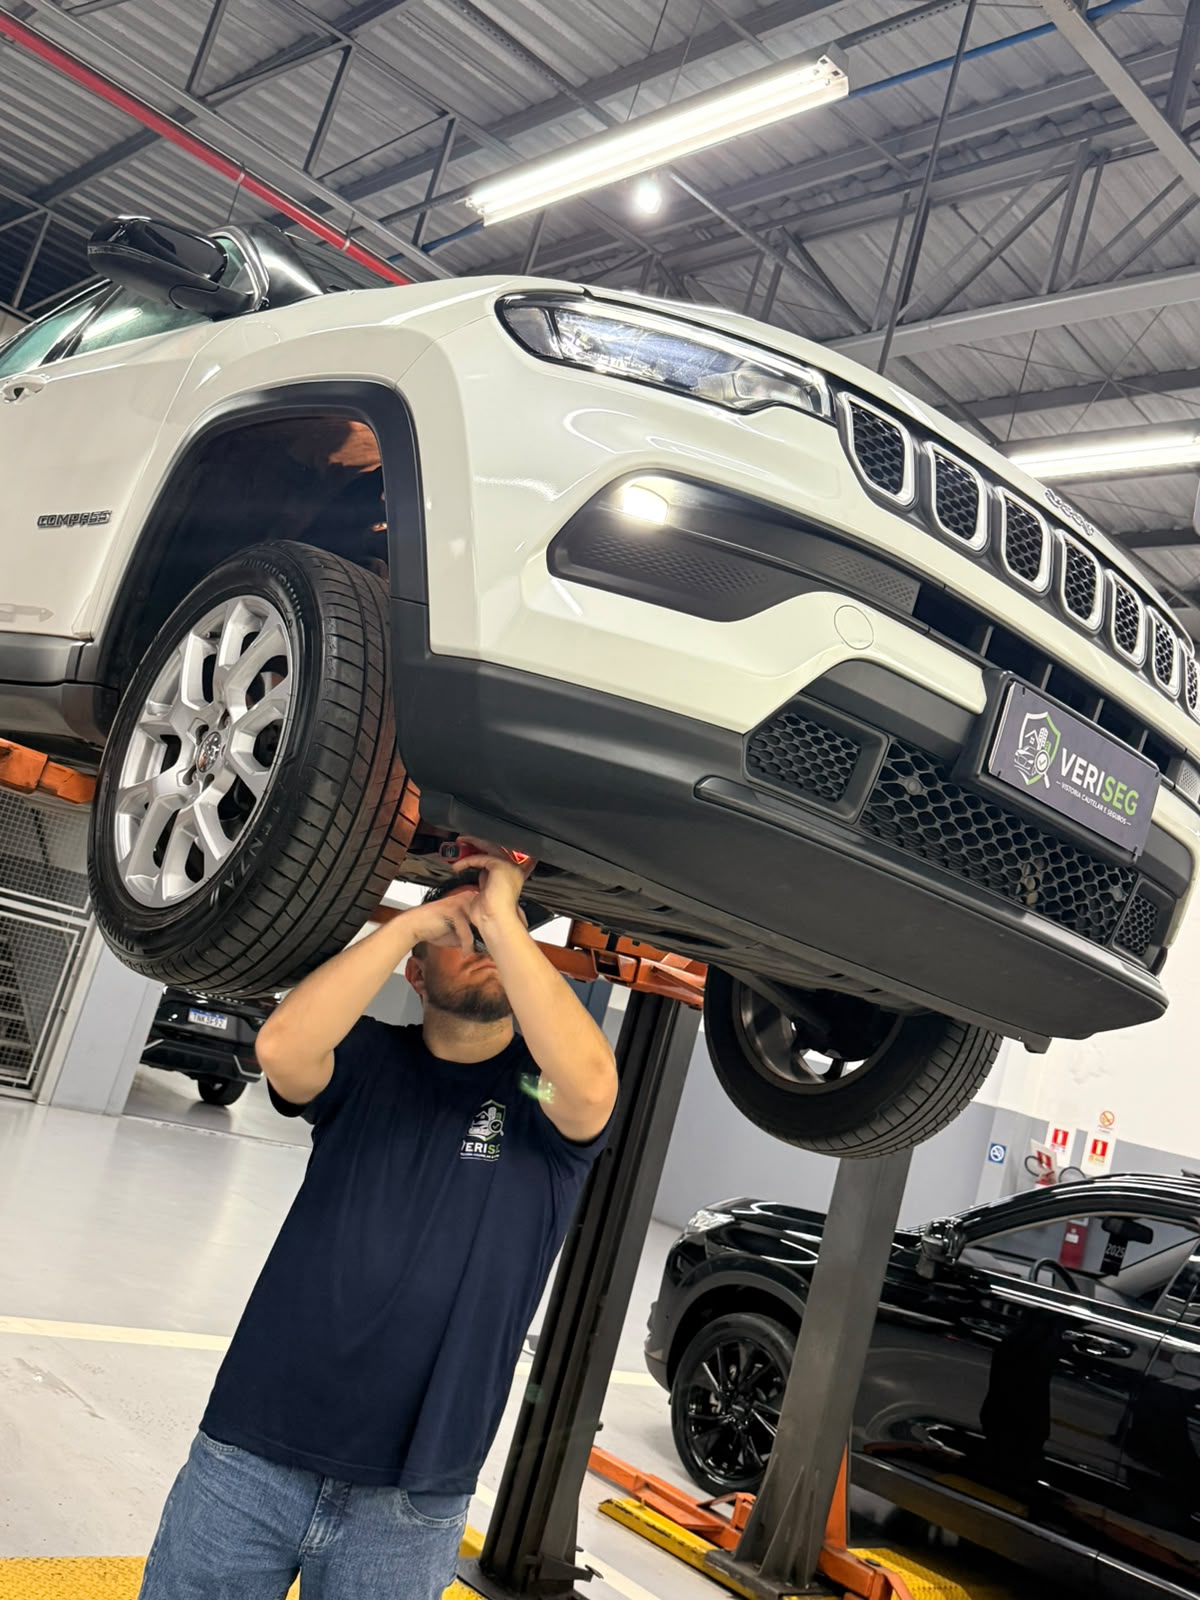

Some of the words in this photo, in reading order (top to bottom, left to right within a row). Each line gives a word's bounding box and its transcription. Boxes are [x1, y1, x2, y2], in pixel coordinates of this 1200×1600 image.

[37, 509, 112, 528] COMPASS
[1061, 747, 1139, 816] VERISEG
[1061, 782, 1081, 798] VISTORIA
[1081, 794, 1104, 811] CAUTELAR
[1107, 808, 1127, 825] SEGUROS
